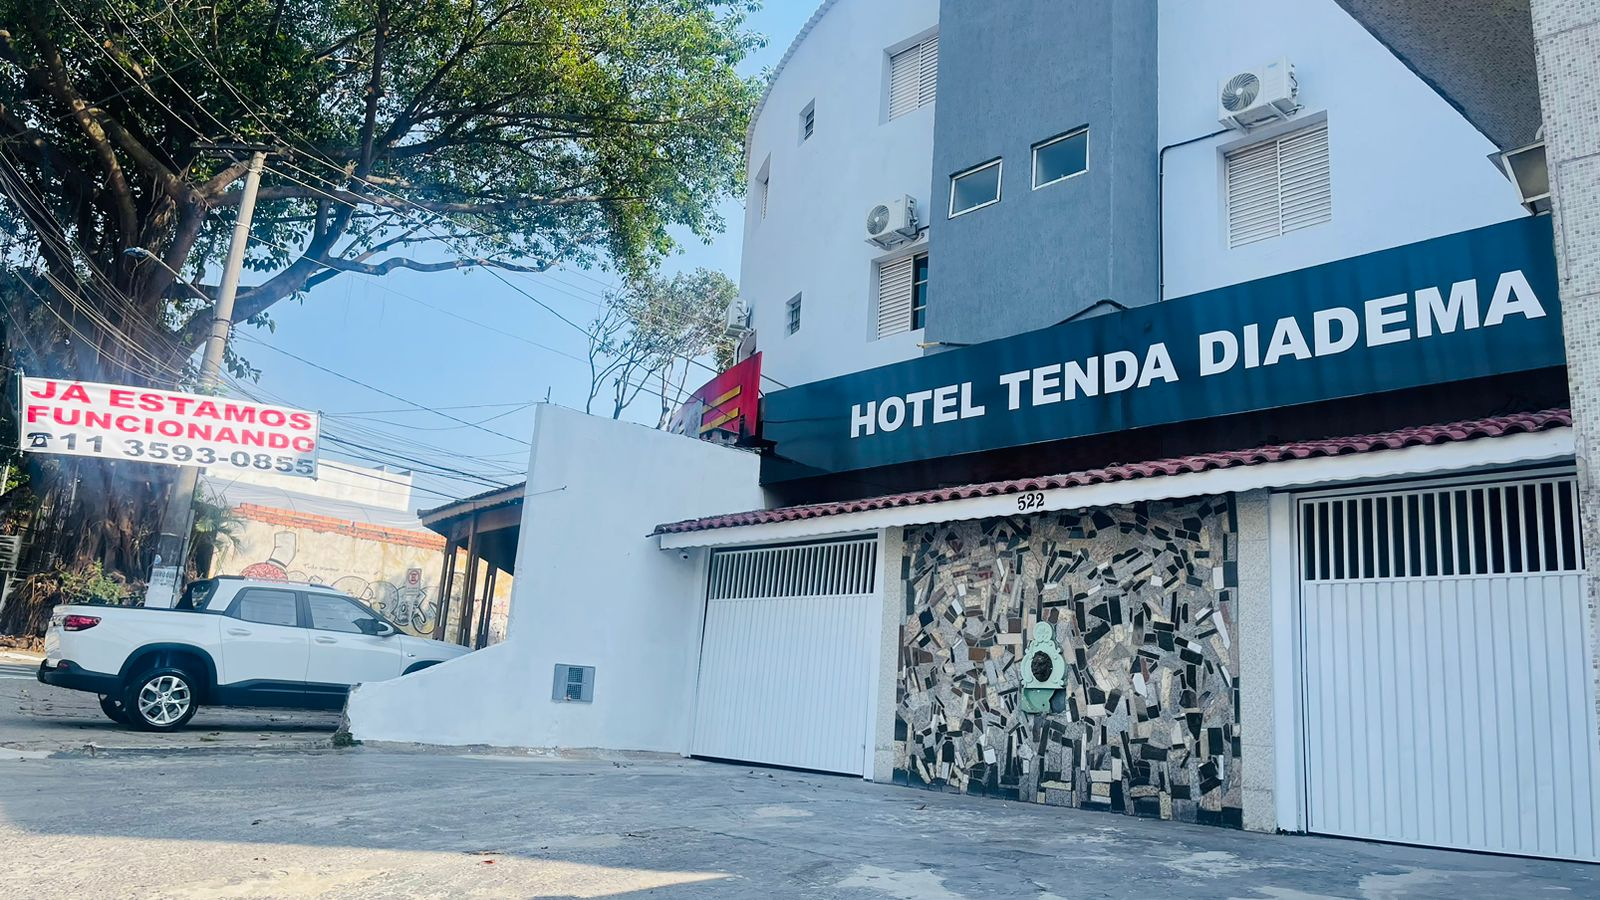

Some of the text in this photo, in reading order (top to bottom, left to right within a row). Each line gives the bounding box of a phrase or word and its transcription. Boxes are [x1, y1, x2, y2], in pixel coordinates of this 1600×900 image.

[851, 269, 1547, 439] HOTEL TENDA DIADEMA
[27, 405, 315, 453] FUNCIONANDO
[30, 380, 312, 431] JÁ ESTAMOS
[60, 433, 314, 475] 11 3593-0855
[1017, 492, 1045, 511] 522
